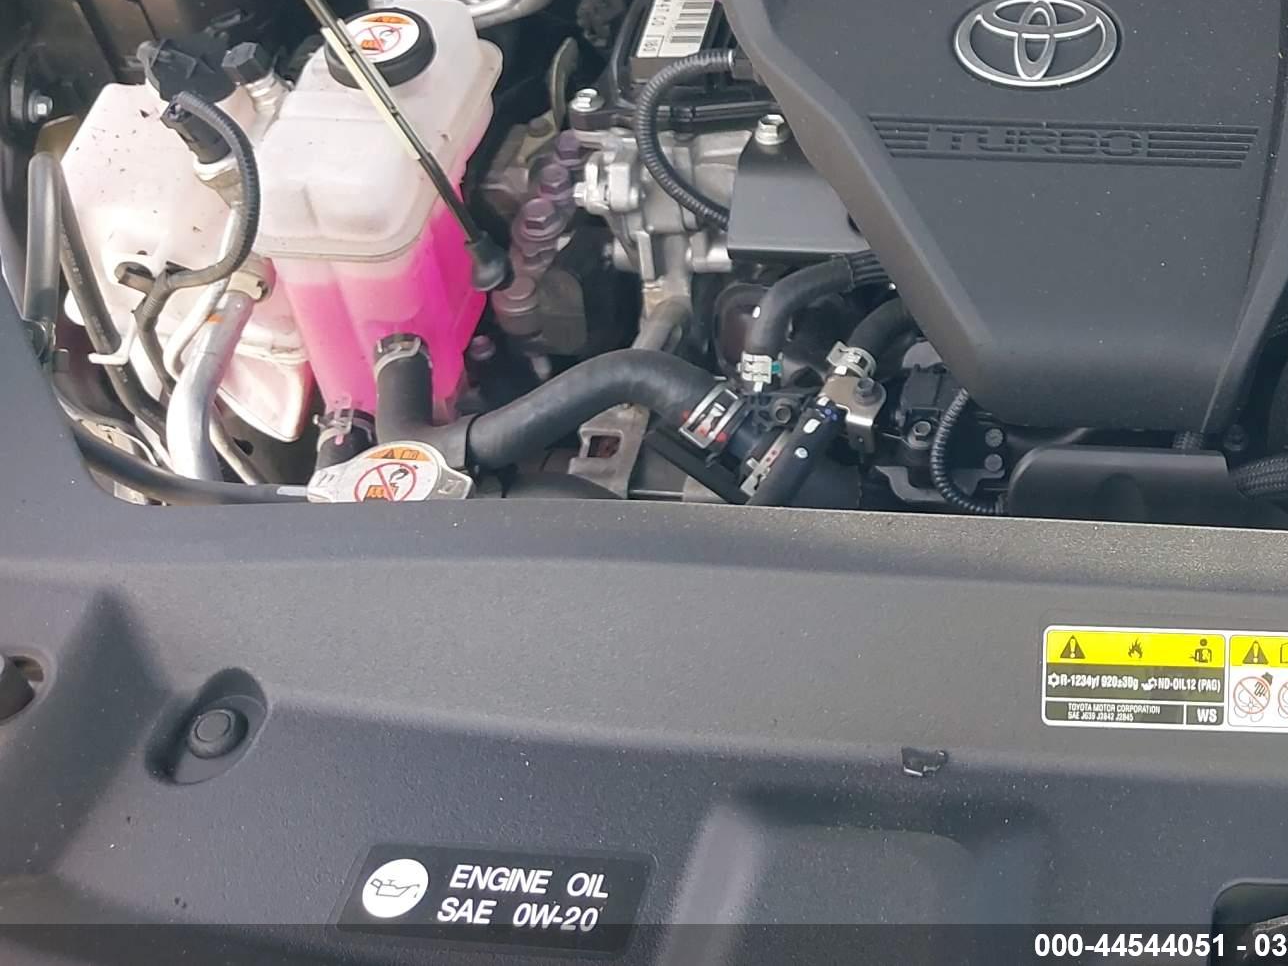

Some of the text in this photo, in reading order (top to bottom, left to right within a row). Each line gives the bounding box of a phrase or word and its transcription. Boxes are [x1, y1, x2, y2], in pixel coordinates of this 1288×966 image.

[934, 125, 1143, 157] TURBO
[1068, 702, 1160, 714] TOYOTA MOTOR CORPORATION
[1068, 711, 1080, 720] SAE
[1197, 709, 1217, 723] WS
[449, 864, 609, 898] ENGINE OIL
[437, 897, 598, 932] SAE 0W-20
